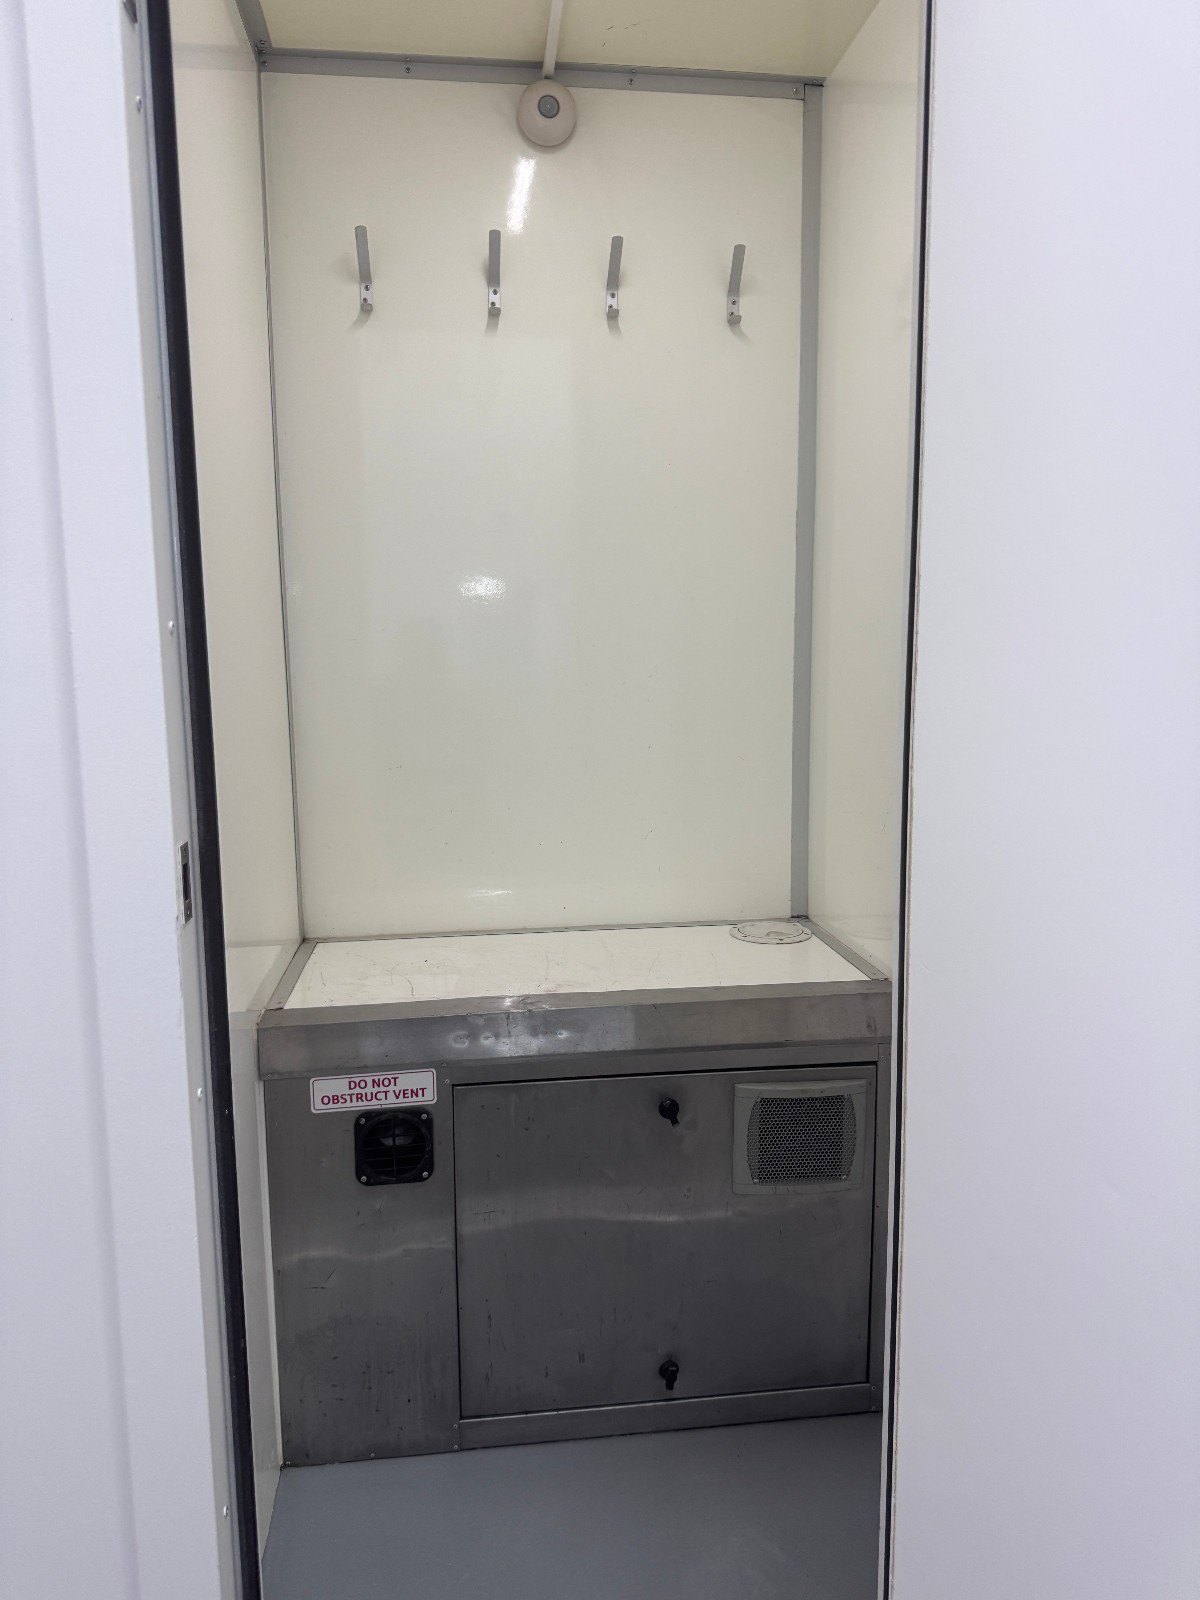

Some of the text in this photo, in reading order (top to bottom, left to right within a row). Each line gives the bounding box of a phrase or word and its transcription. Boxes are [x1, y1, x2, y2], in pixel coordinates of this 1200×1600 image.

[348, 1076, 399, 1091] DO NOT
[321, 1087, 427, 1106] OBSTRUCT VENT
